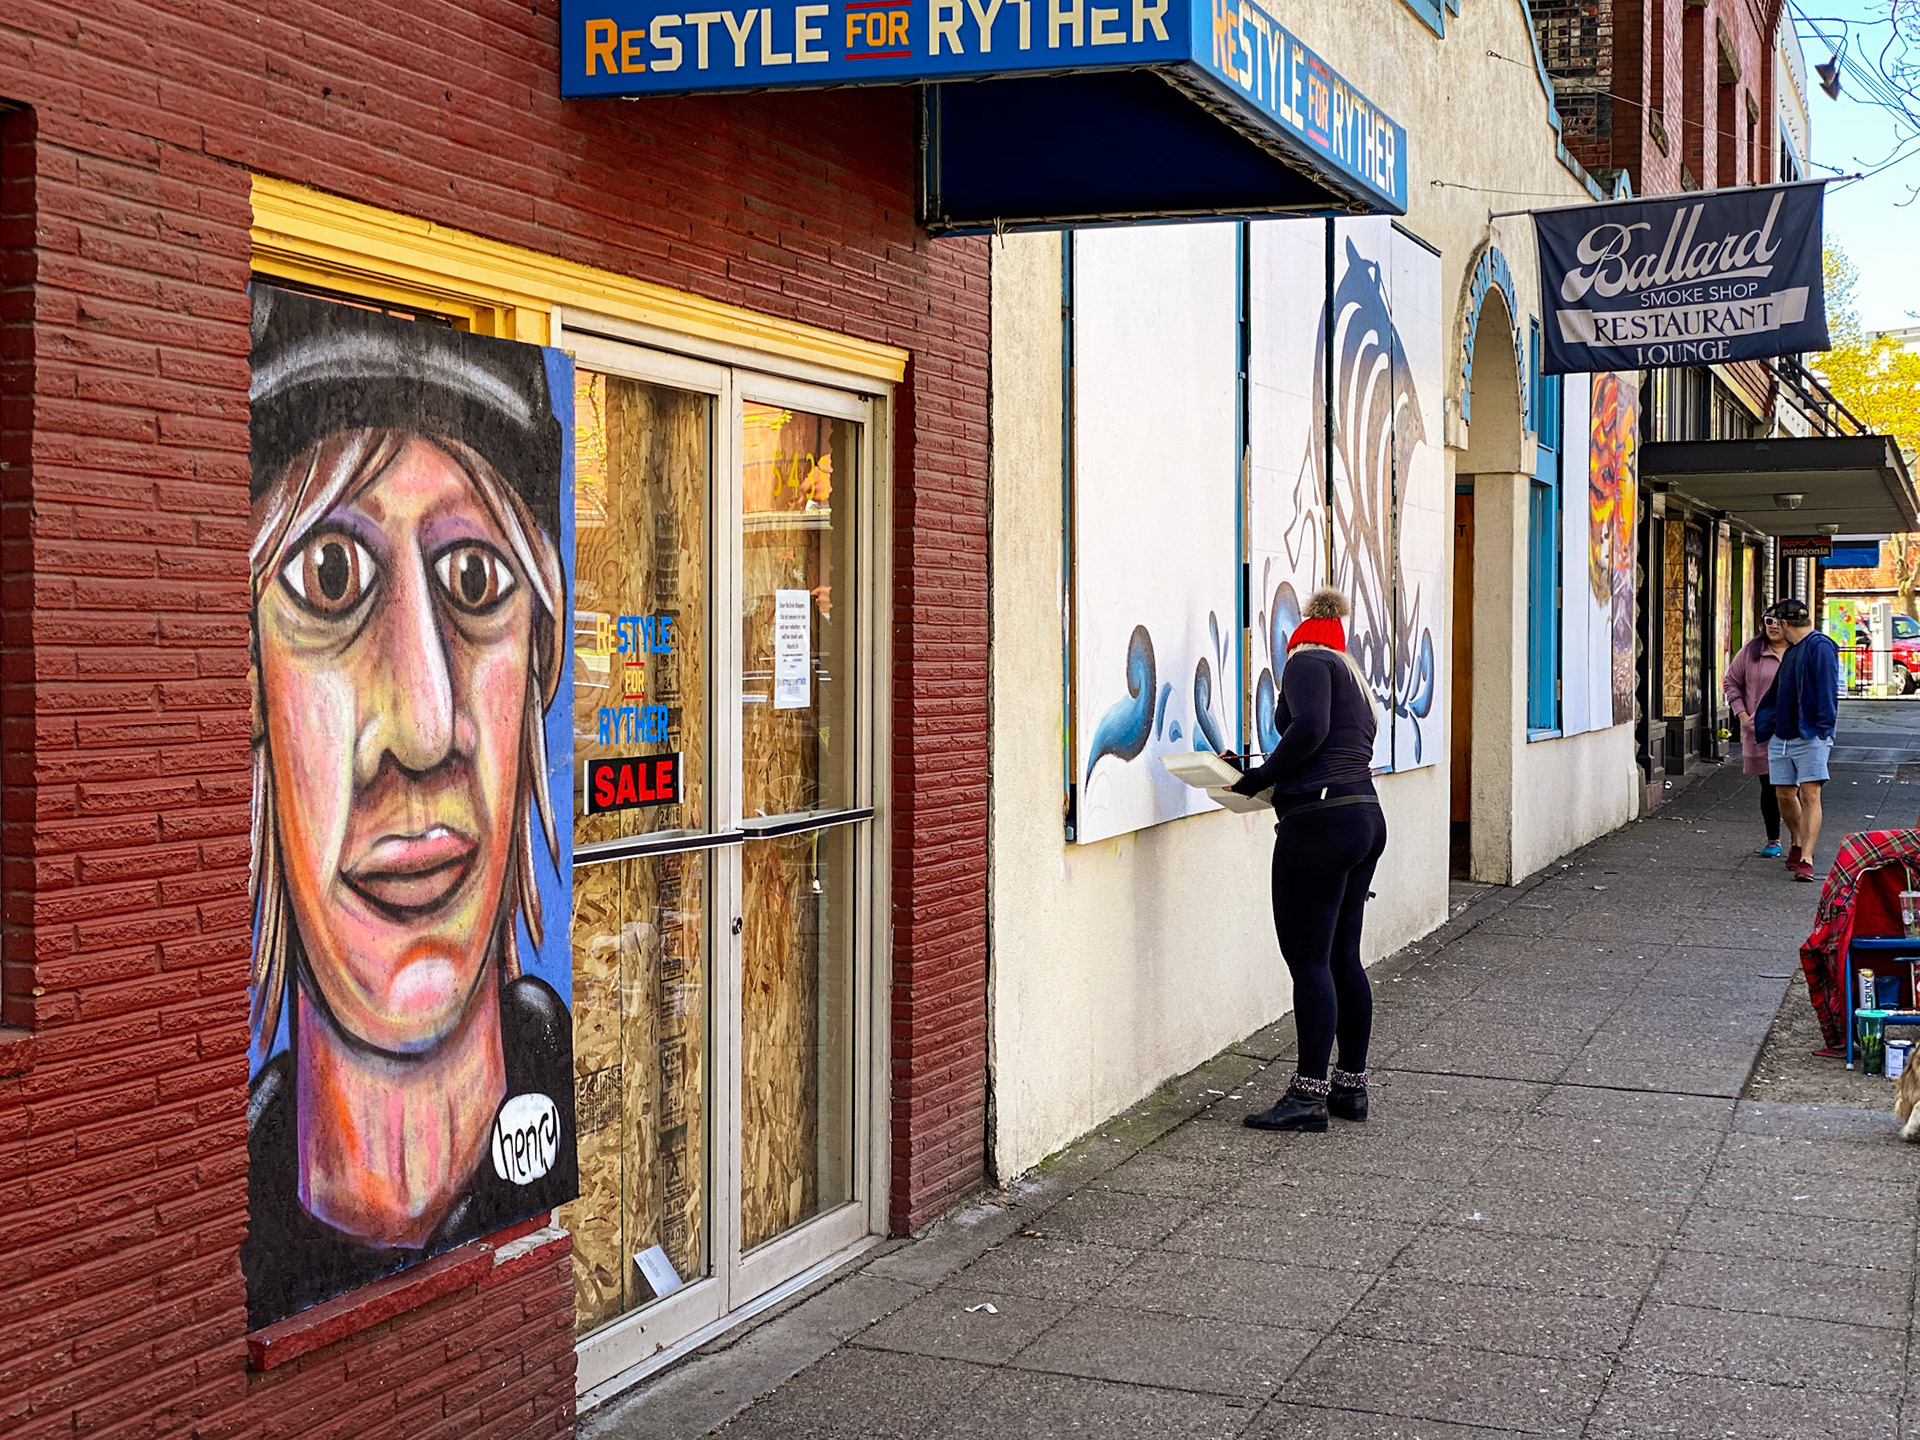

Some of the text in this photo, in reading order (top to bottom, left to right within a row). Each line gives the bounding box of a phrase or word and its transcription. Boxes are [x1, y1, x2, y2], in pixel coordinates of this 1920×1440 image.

[585, 0, 1169, 76] ReSTYLE FOR RYTHER
[1212, 0, 1396, 198] ReSTYLE FOR RYTHER
[1560, 191, 1785, 303] Ballard
[1640, 283, 1759, 307] SMOKE SHOP
[1593, 302, 1774, 347] RESTAURANT
[1636, 340, 1732, 366] LOUNGE
[1782, 547, 1829, 557] patagonia
[596, 614, 672, 655] ReSTYLE
[625, 670, 645, 694] FOR
[599, 704, 669, 746] RYTHER
[594, 760, 673, 807] SALE
[1864, 978, 1872, 1004] TRULY
[497, 1105, 559, 1181] henry
